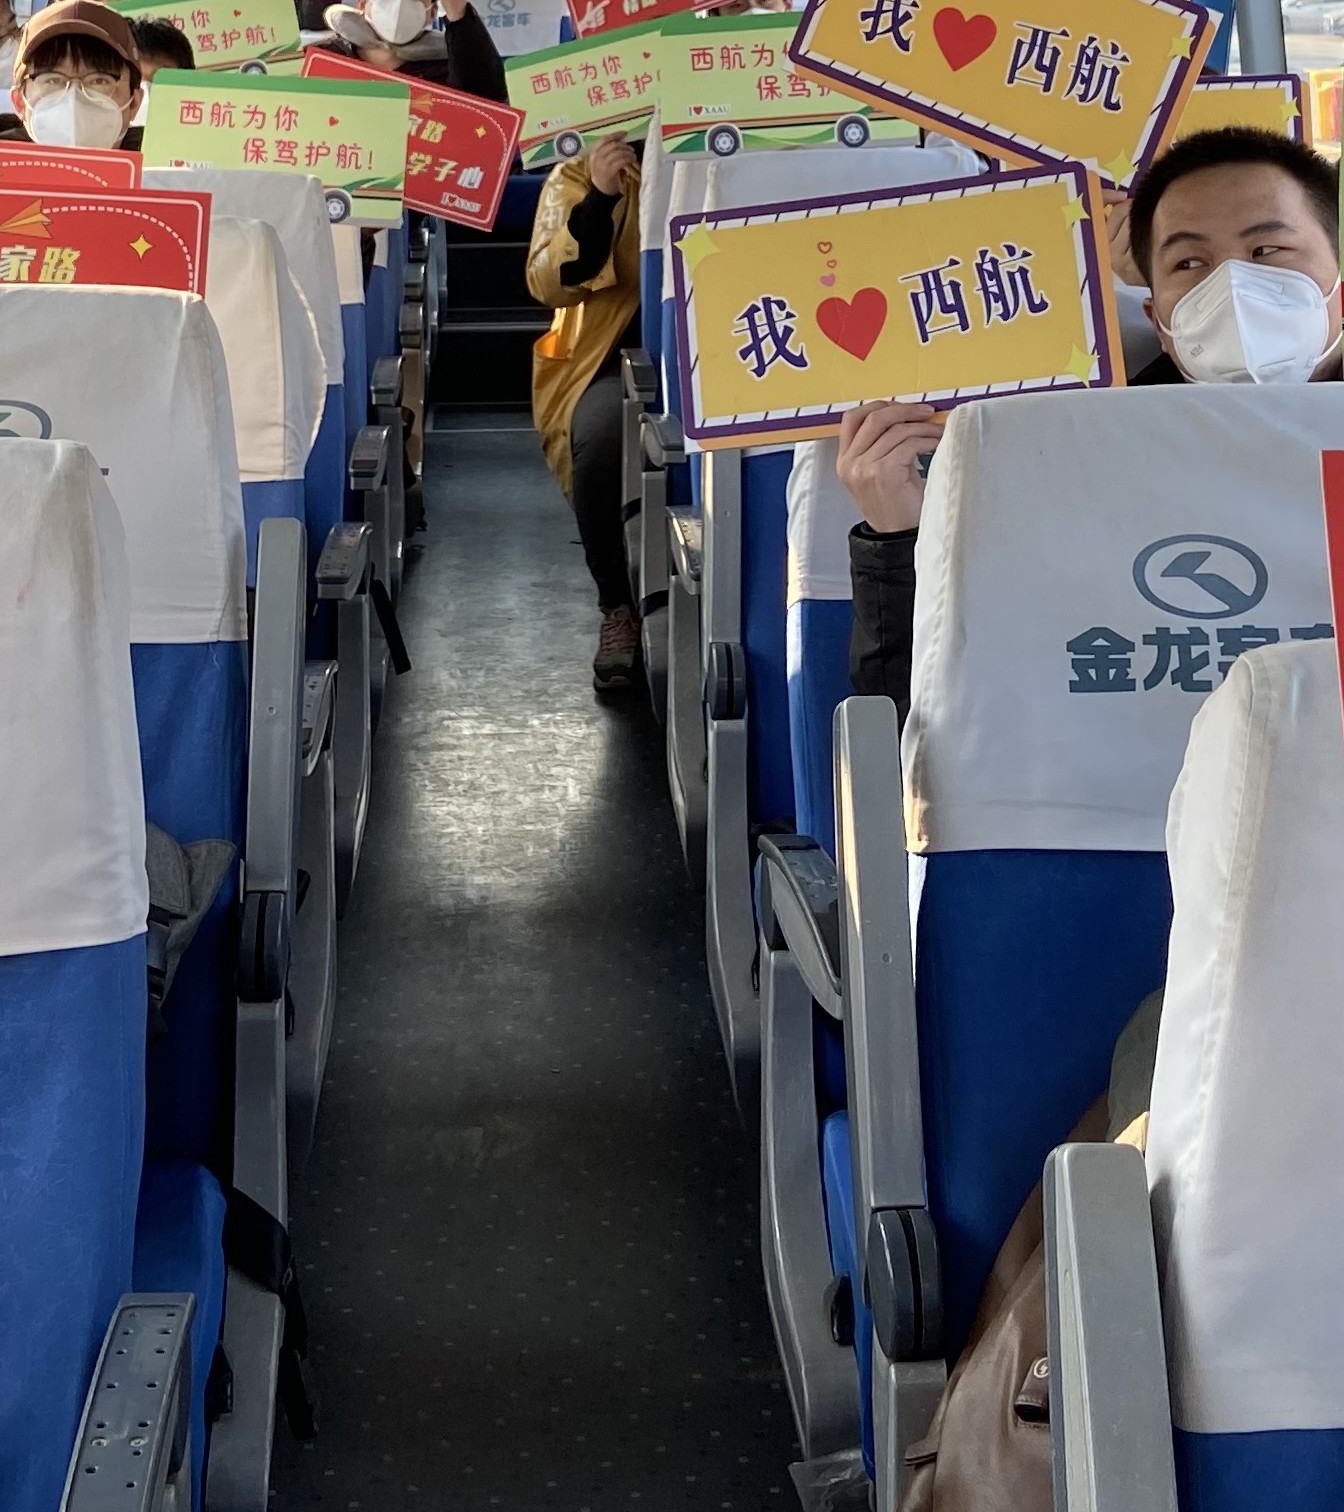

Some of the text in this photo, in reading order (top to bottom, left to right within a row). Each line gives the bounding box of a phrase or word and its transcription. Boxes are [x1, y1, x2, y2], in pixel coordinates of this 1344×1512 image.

[480, 13, 532, 28] 龙客车
[530, 55, 622, 95] 西航为你
[689, 44, 790, 72] 西航为
[1006, 20, 1132, 114] 西航
[587, 67, 661, 107] 保驾护
[179, 99, 300, 132] 西航为你
[243, 138, 374, 171] 保驾护航!
[733, 242, 1051, 379] 我 西航
[1066, 624, 1335, 693] 金龙
